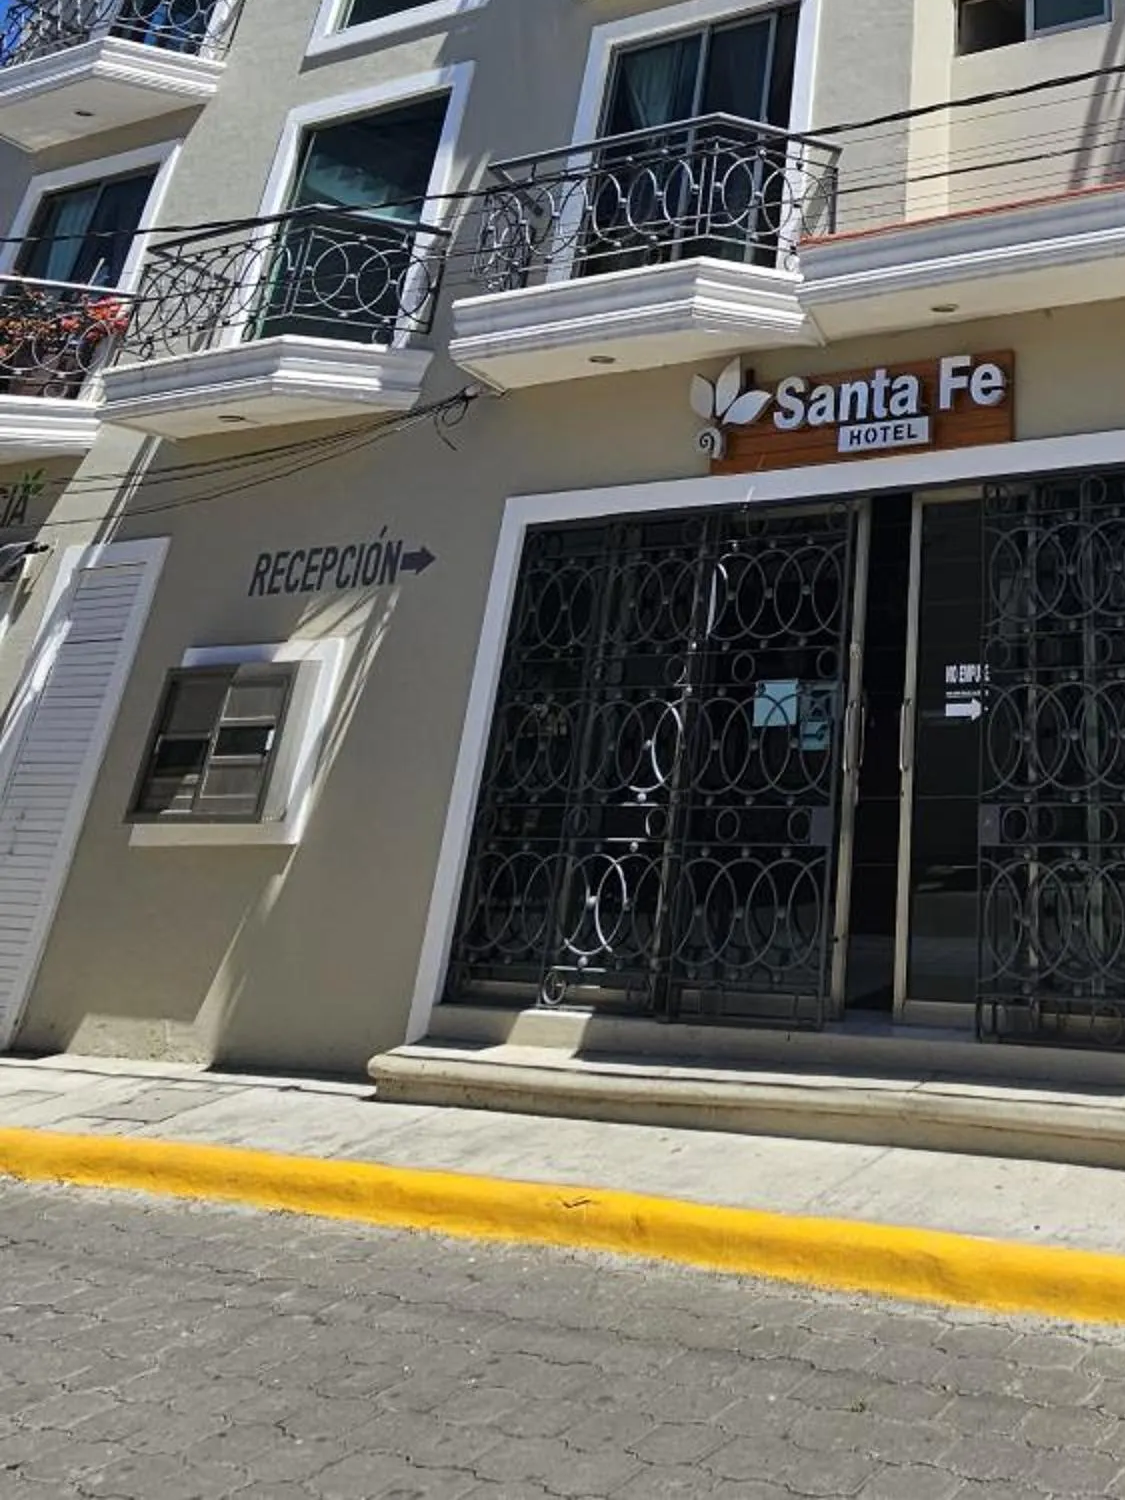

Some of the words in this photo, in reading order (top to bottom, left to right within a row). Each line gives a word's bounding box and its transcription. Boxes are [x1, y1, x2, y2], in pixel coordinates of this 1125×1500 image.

[774, 368, 921, 430] Santa
[939, 355, 1006, 411] Fe
[849, 423, 918, 446] HOTEL
[248, 525, 403, 596] RECEPCIÓN
